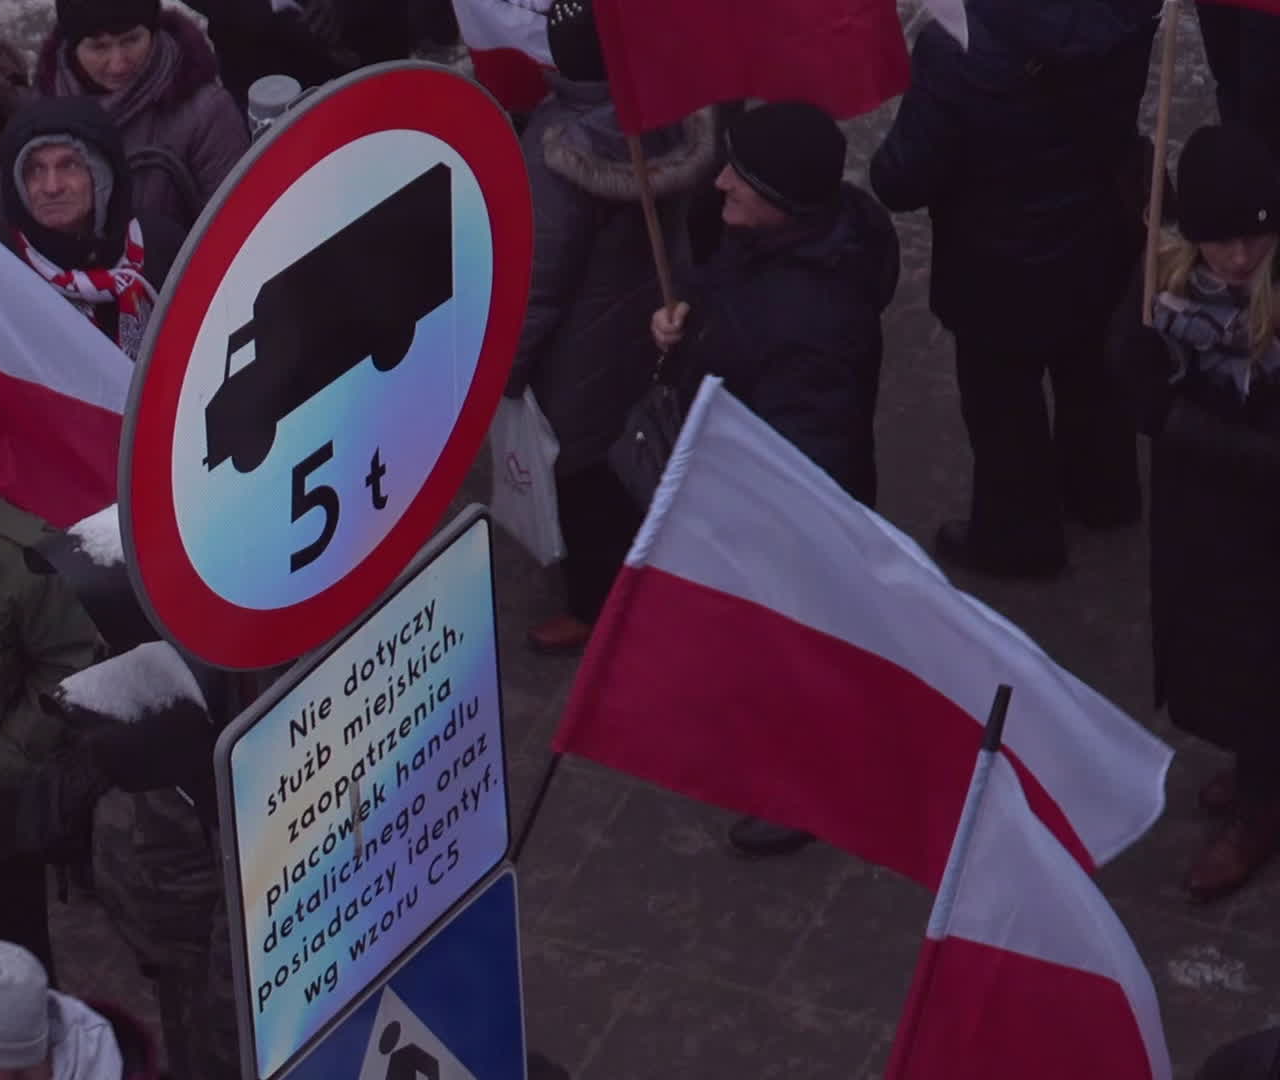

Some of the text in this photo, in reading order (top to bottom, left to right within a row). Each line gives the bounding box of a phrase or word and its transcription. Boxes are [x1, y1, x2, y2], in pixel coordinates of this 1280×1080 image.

[290, 440, 388, 574] 5 t
[267, 625, 465, 816] służb miejskich,
[287, 677, 452, 843] zaopatrzenia
[289, 599, 436, 748] Nie dotyczy
[257, 763, 498, 1013] posiadaczy identyf.
[263, 732, 487, 953] detalicznego oraz
[266, 695, 479, 917] placówek handlu
[303, 839, 460, 1004] wg wzoru C5
